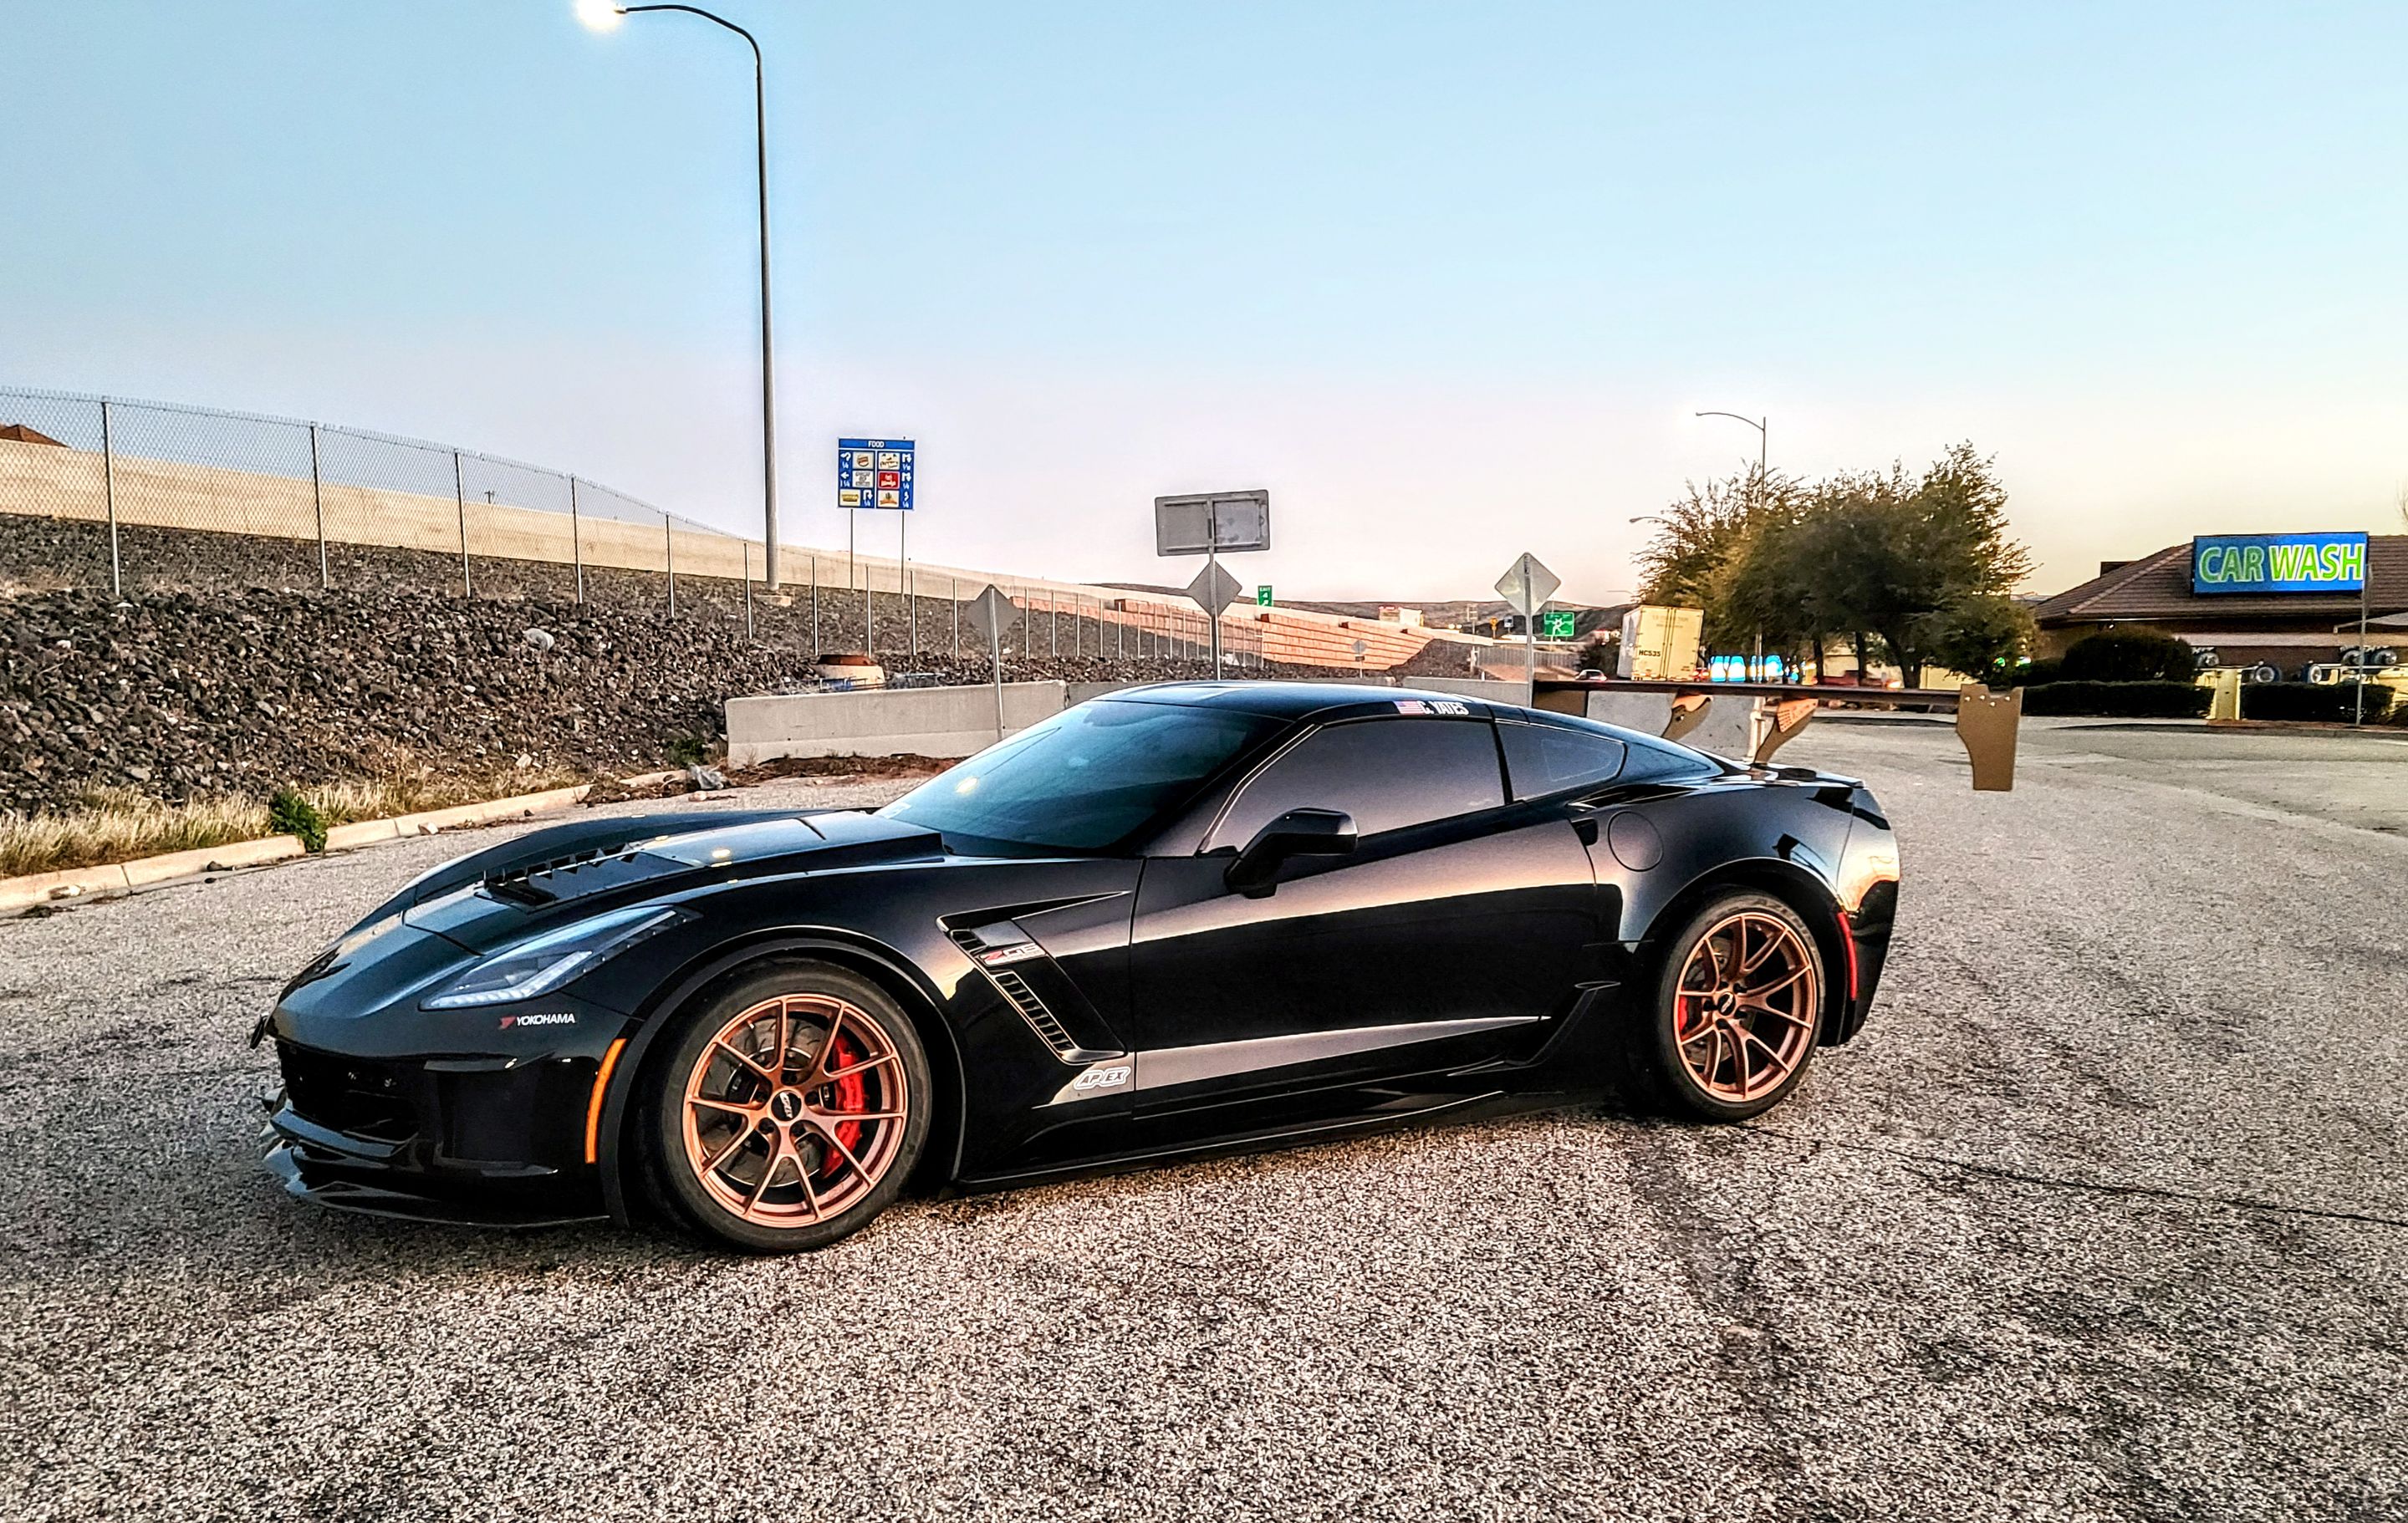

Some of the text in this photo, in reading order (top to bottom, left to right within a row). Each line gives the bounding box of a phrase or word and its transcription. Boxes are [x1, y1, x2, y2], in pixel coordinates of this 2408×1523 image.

[2199, 542, 2365, 583] CAR WASH
[1417, 700, 1470, 716] C. YATES
[517, 1013, 575, 1026] YOKOHAMA
